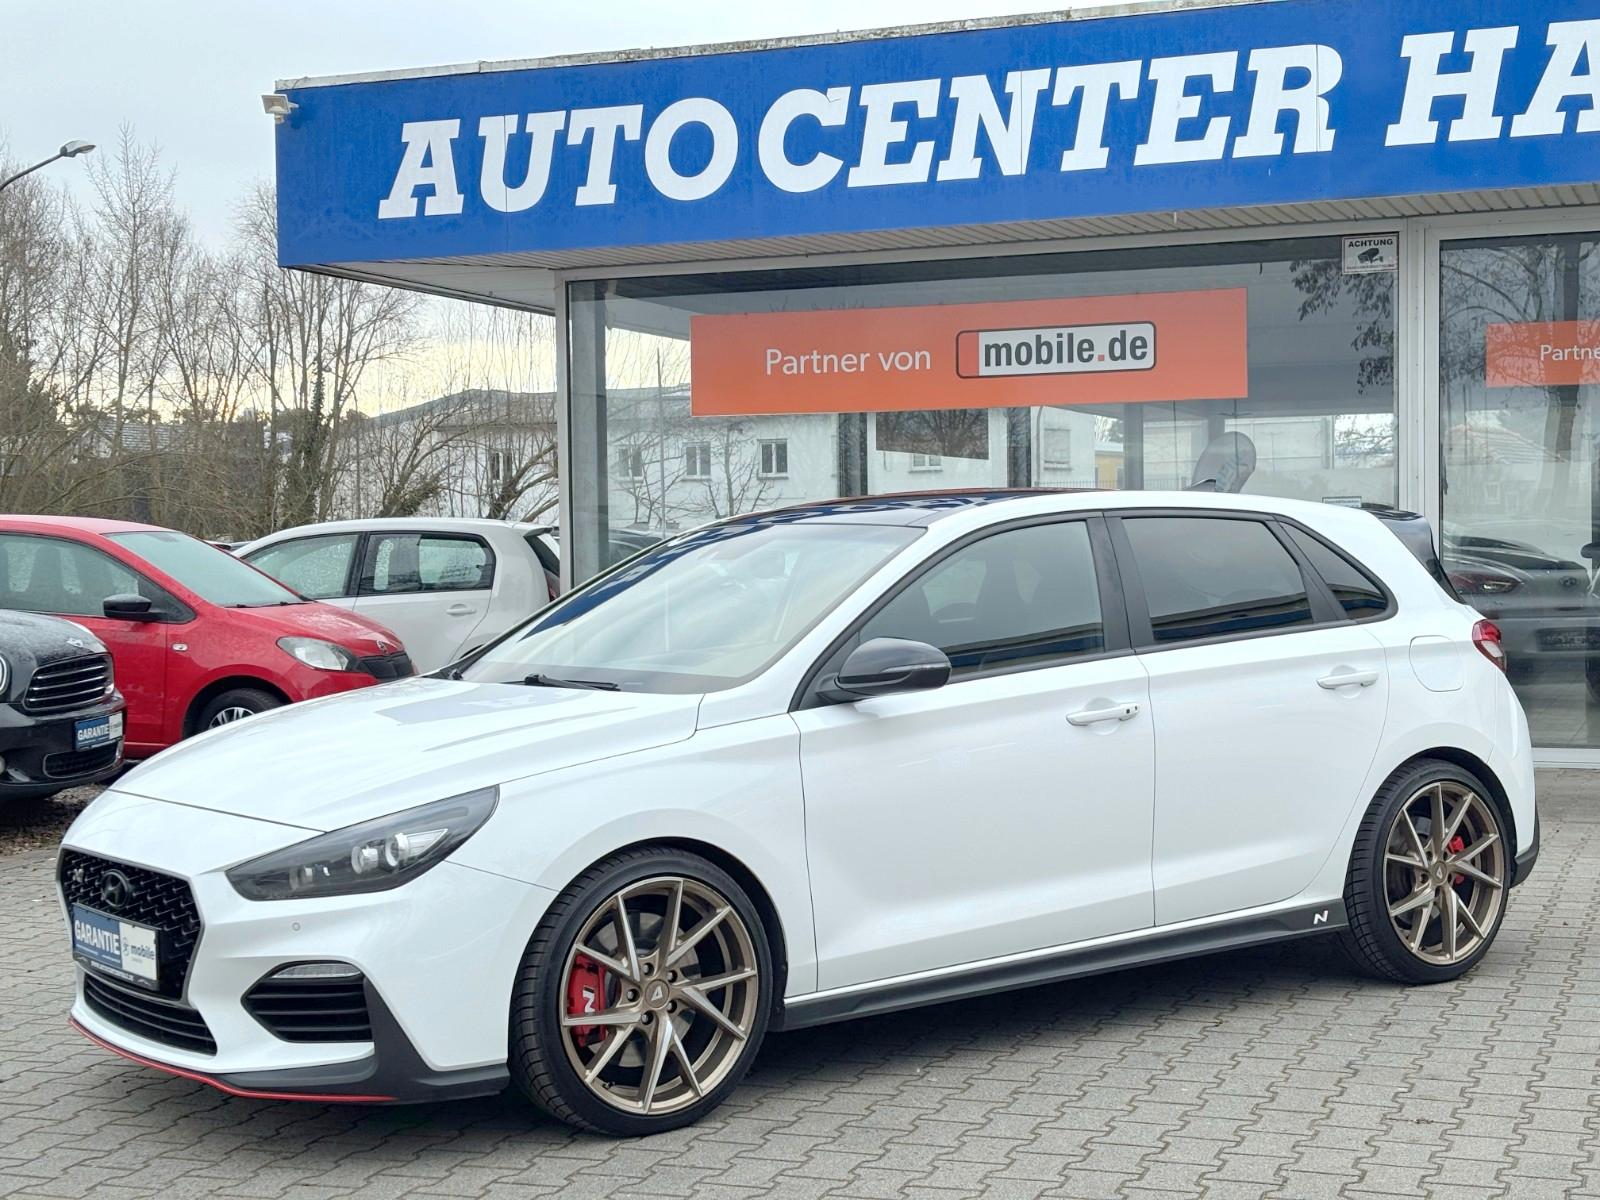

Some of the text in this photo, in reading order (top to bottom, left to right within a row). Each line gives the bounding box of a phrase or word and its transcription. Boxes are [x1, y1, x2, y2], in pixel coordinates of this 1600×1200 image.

[1385, 19, 1600, 147] HA
[1348, 238, 1394, 248] ACHTUNG
[766, 348, 931, 375] Partner von
[984, 329, 1149, 368] mobile.de
[77, 723, 110, 741] GARANTIE
[74, 919, 121, 956] GARANTIE
